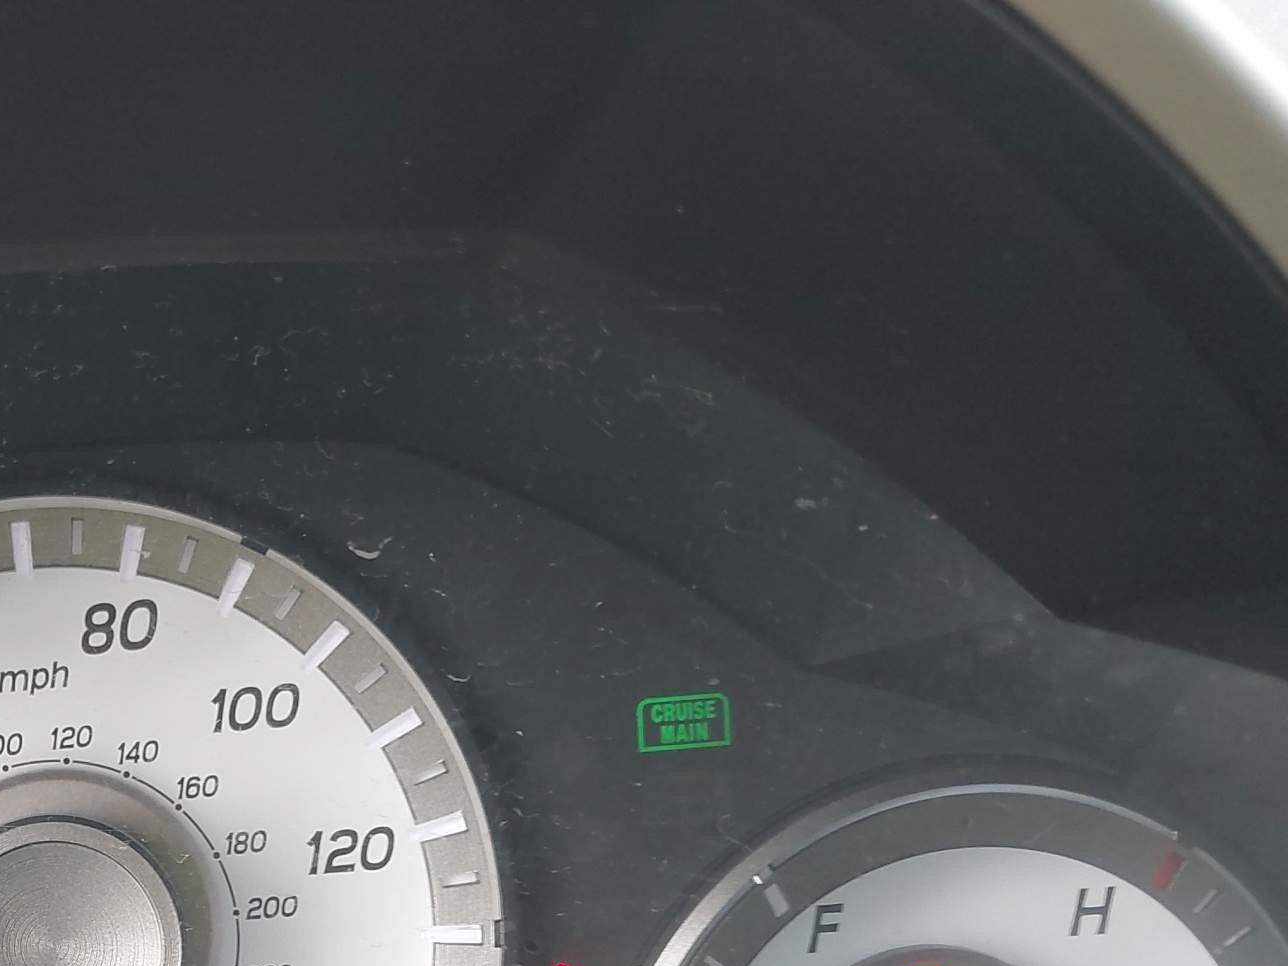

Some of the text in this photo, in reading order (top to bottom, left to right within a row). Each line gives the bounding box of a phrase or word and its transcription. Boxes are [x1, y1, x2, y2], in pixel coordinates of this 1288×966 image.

[80, 598, 158, 656] 80
[210, 683, 300, 732] 100
[652, 700, 716, 723] CRUISE
[50, 724, 93, 750] 120
[117, 739, 159, 765] 140
[177, 774, 219, 801] 160
[225, 830, 267, 855] 180
[307, 826, 395, 877] 120
[246, 895, 298, 921] 200
[1070, 886, 1116, 937] H
[807, 903, 844, 954] F
